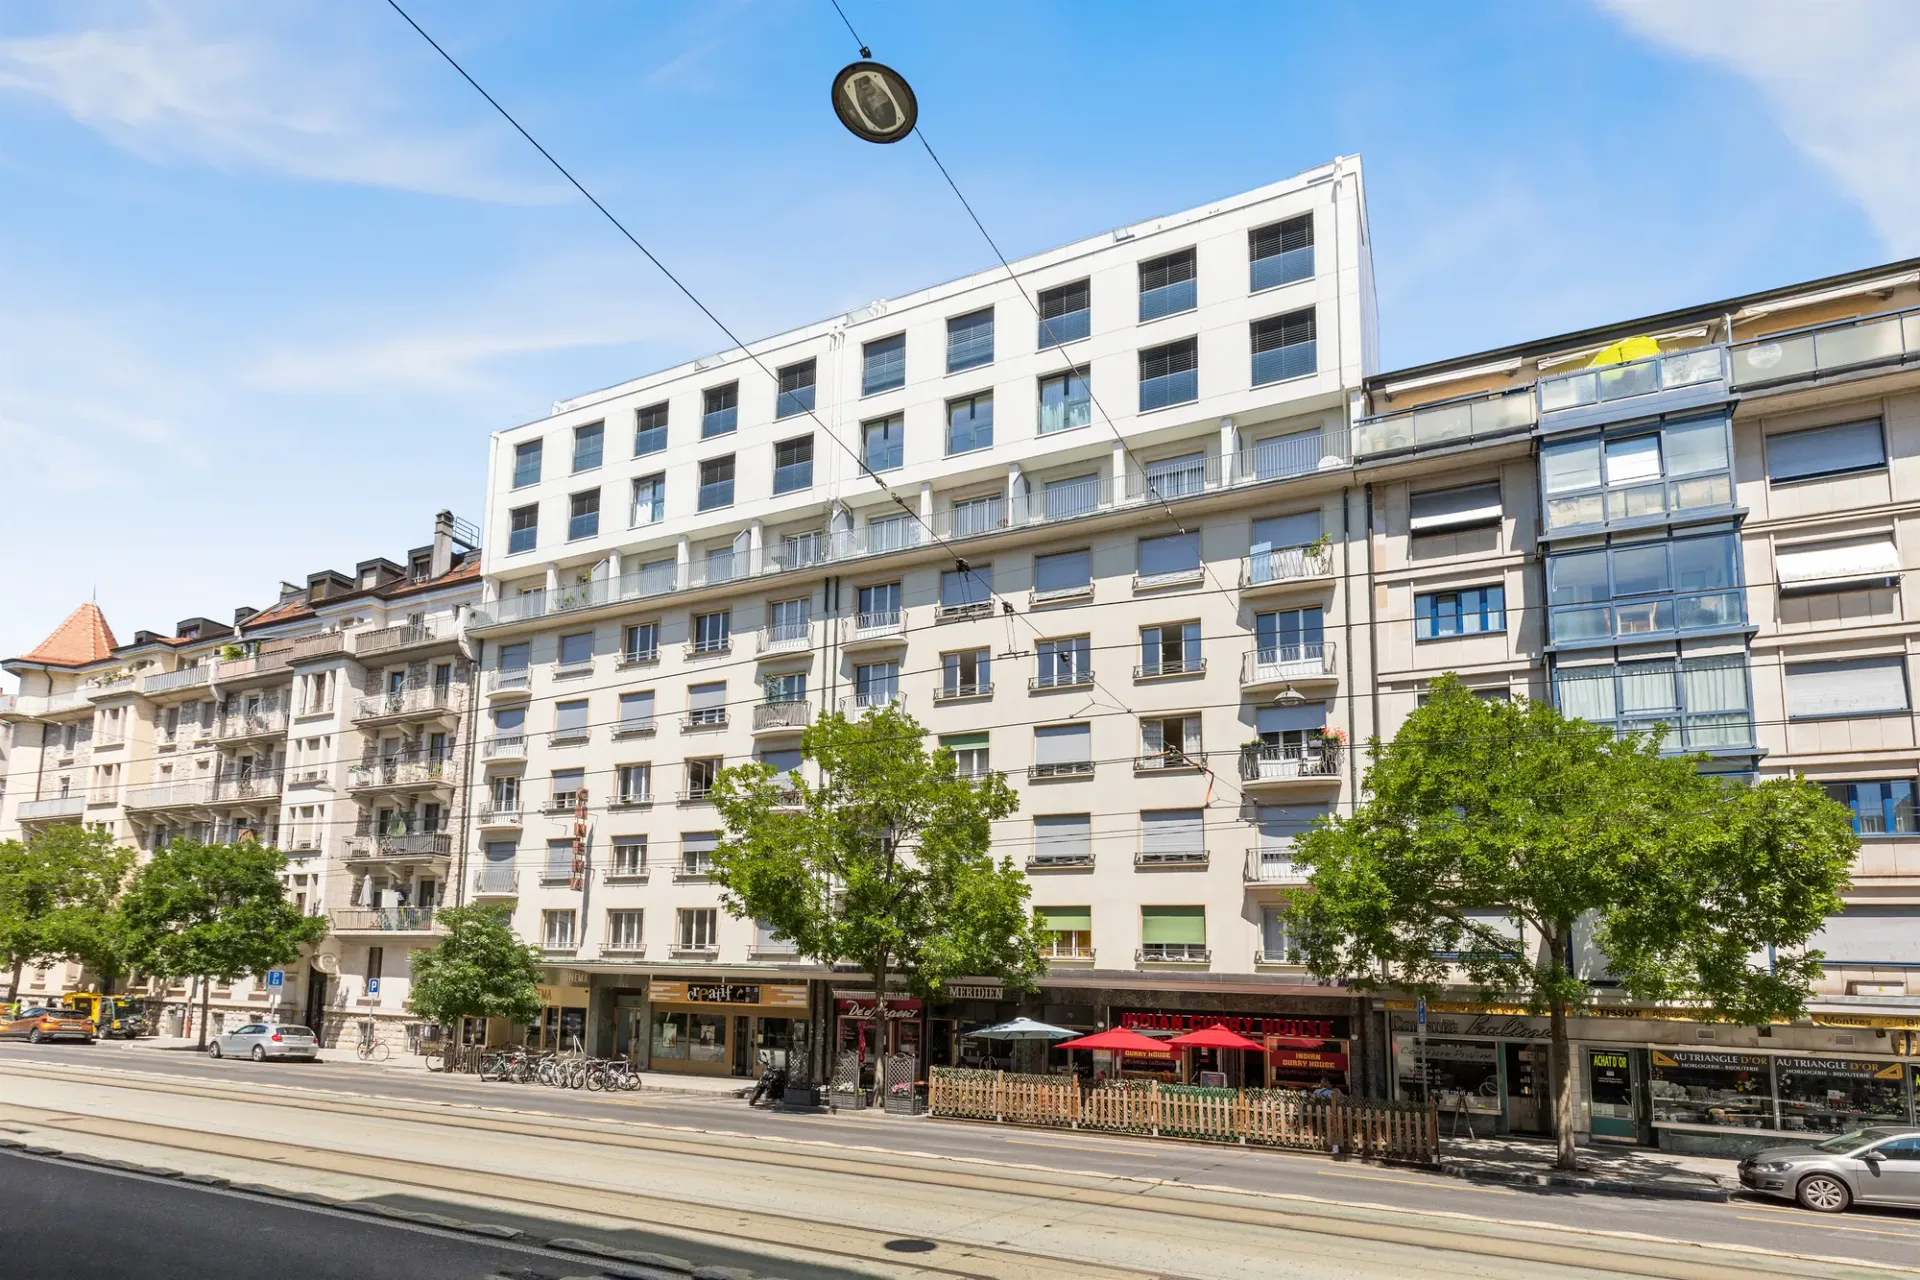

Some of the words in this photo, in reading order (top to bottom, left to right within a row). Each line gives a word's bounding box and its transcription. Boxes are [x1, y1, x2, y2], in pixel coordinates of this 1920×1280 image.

[950, 986, 1003, 1000] MERIDIEN
[1599, 1008, 1642, 1018] TISSOT
[1122, 1012, 1183, 1031] INDIAN
[1189, 1014, 1254, 1034] CURRY
[1261, 1017, 1335, 1038] HOUSE
[1824, 1015, 1872, 1026] Montres
[1282, 1059, 1307, 1067] CURRY
[1308, 1061, 1336, 1069] HOUSE
[1593, 1055, 1611, 1067] ACHAT
[1673, 1052, 1686, 1061] AU
[1688, 1053, 1738, 1064] TRIANGLE
[1741, 1056, 1768, 1065] D'OR
[1776, 1058, 1791, 1067] AU
[1795, 1059, 1847, 1070] TRIANGLE
[1851, 1063, 1879, 1072] D'OR
